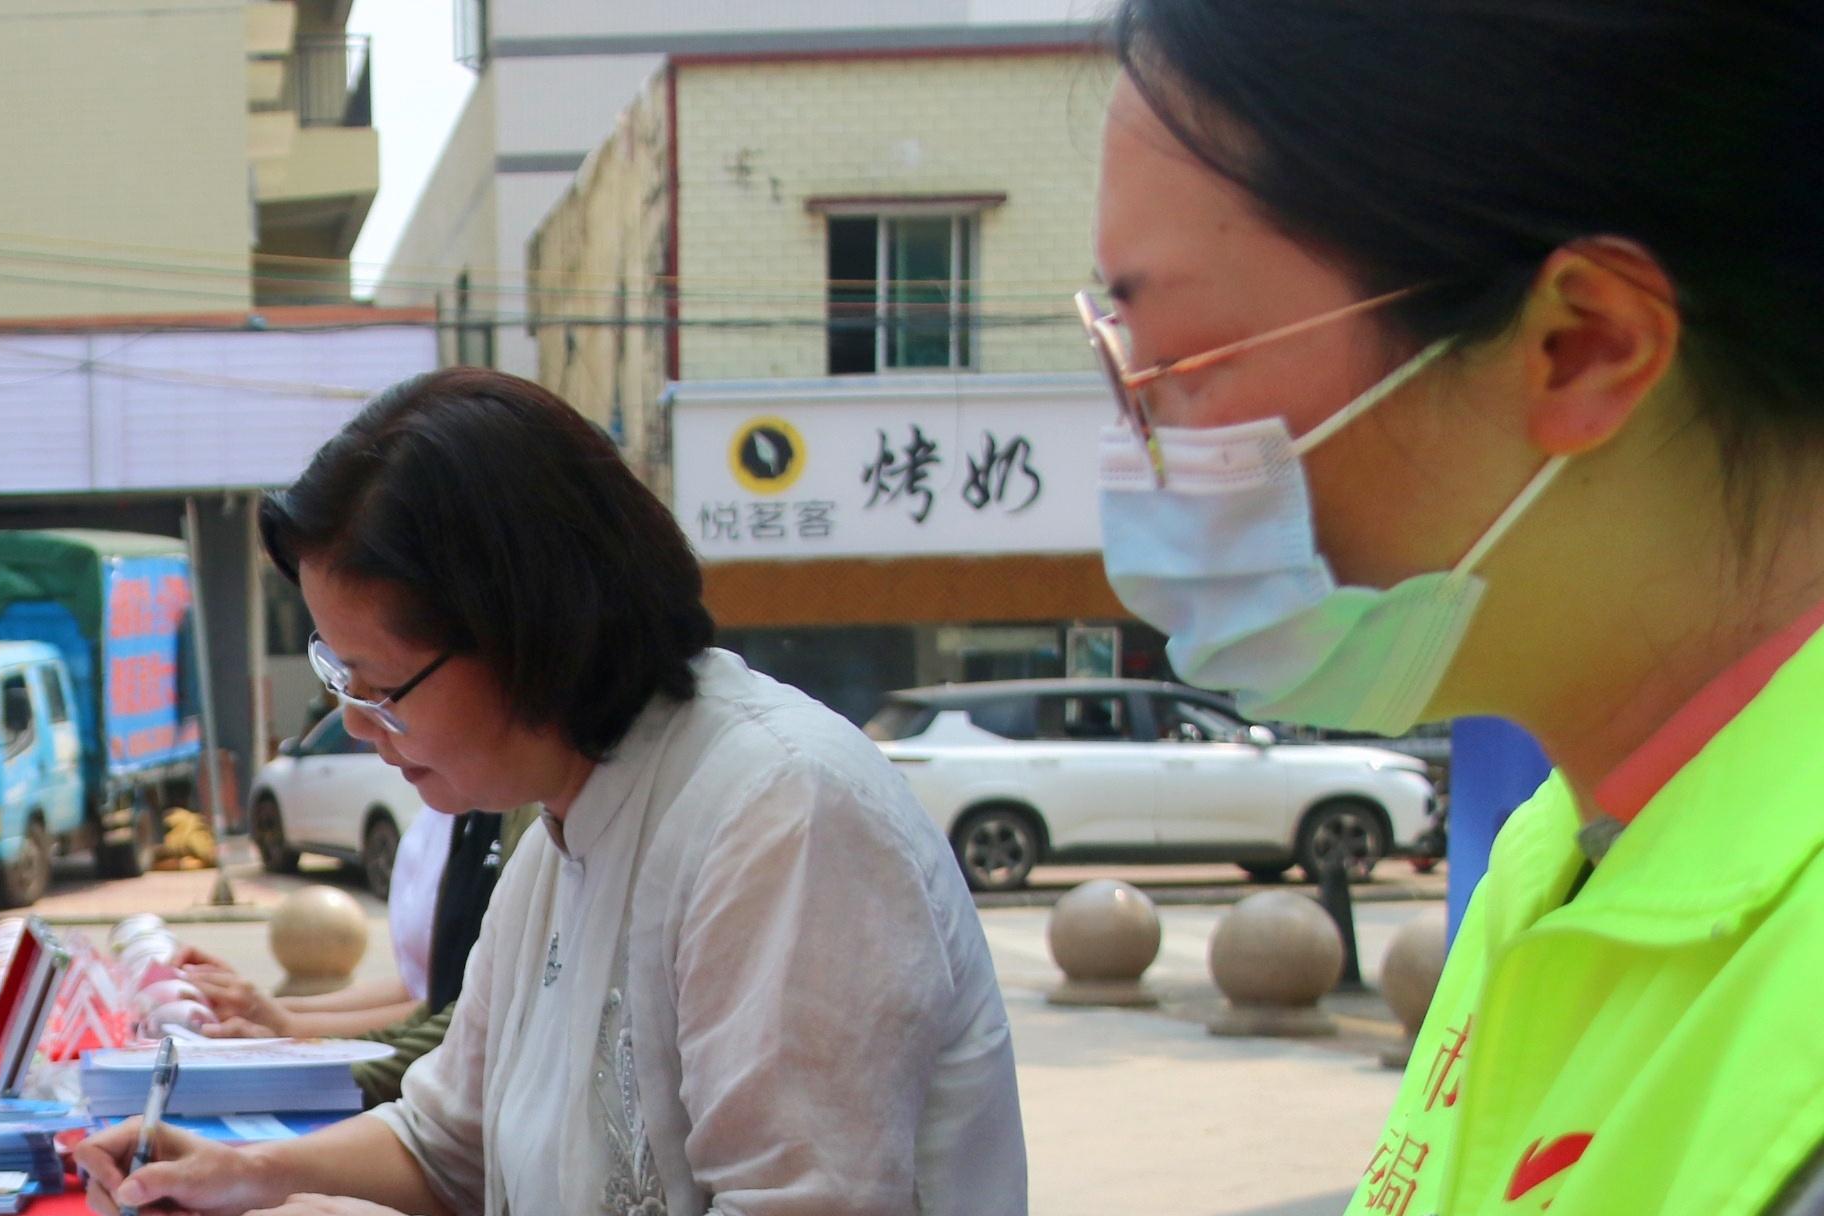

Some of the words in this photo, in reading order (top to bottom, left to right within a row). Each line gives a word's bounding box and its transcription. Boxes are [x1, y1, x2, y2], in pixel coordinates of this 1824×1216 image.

[860, 423, 1041, 524] 烤奶
[695, 500, 836, 541] 悦茗客
